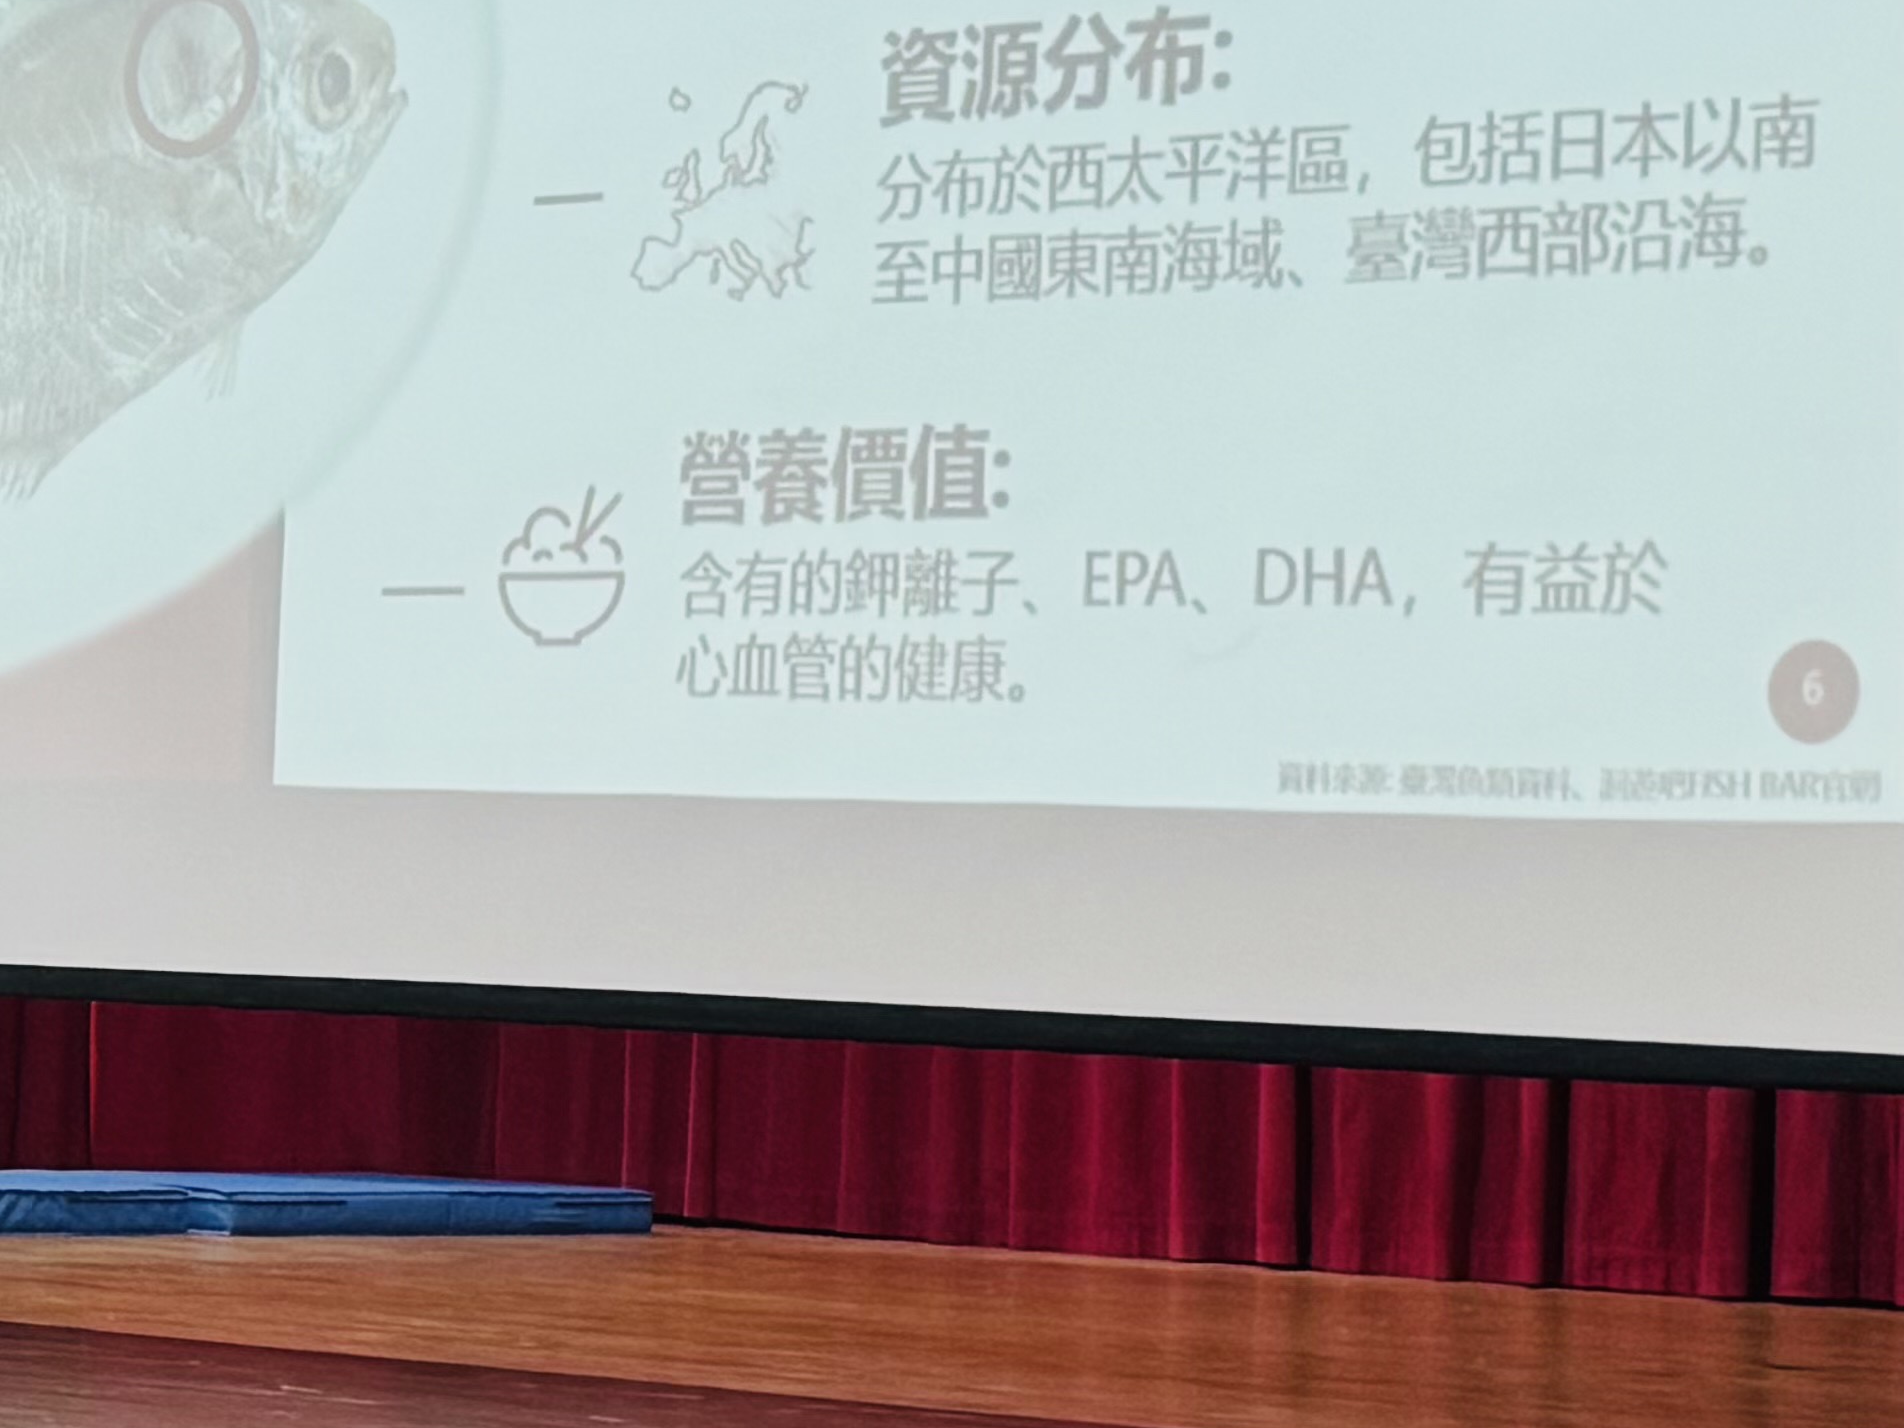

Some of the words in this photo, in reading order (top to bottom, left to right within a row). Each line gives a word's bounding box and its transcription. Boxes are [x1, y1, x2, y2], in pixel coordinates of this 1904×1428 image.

[676, 632, 1026, 704] 心血管的健康。
[1802, 670, 1824, 706] 6
